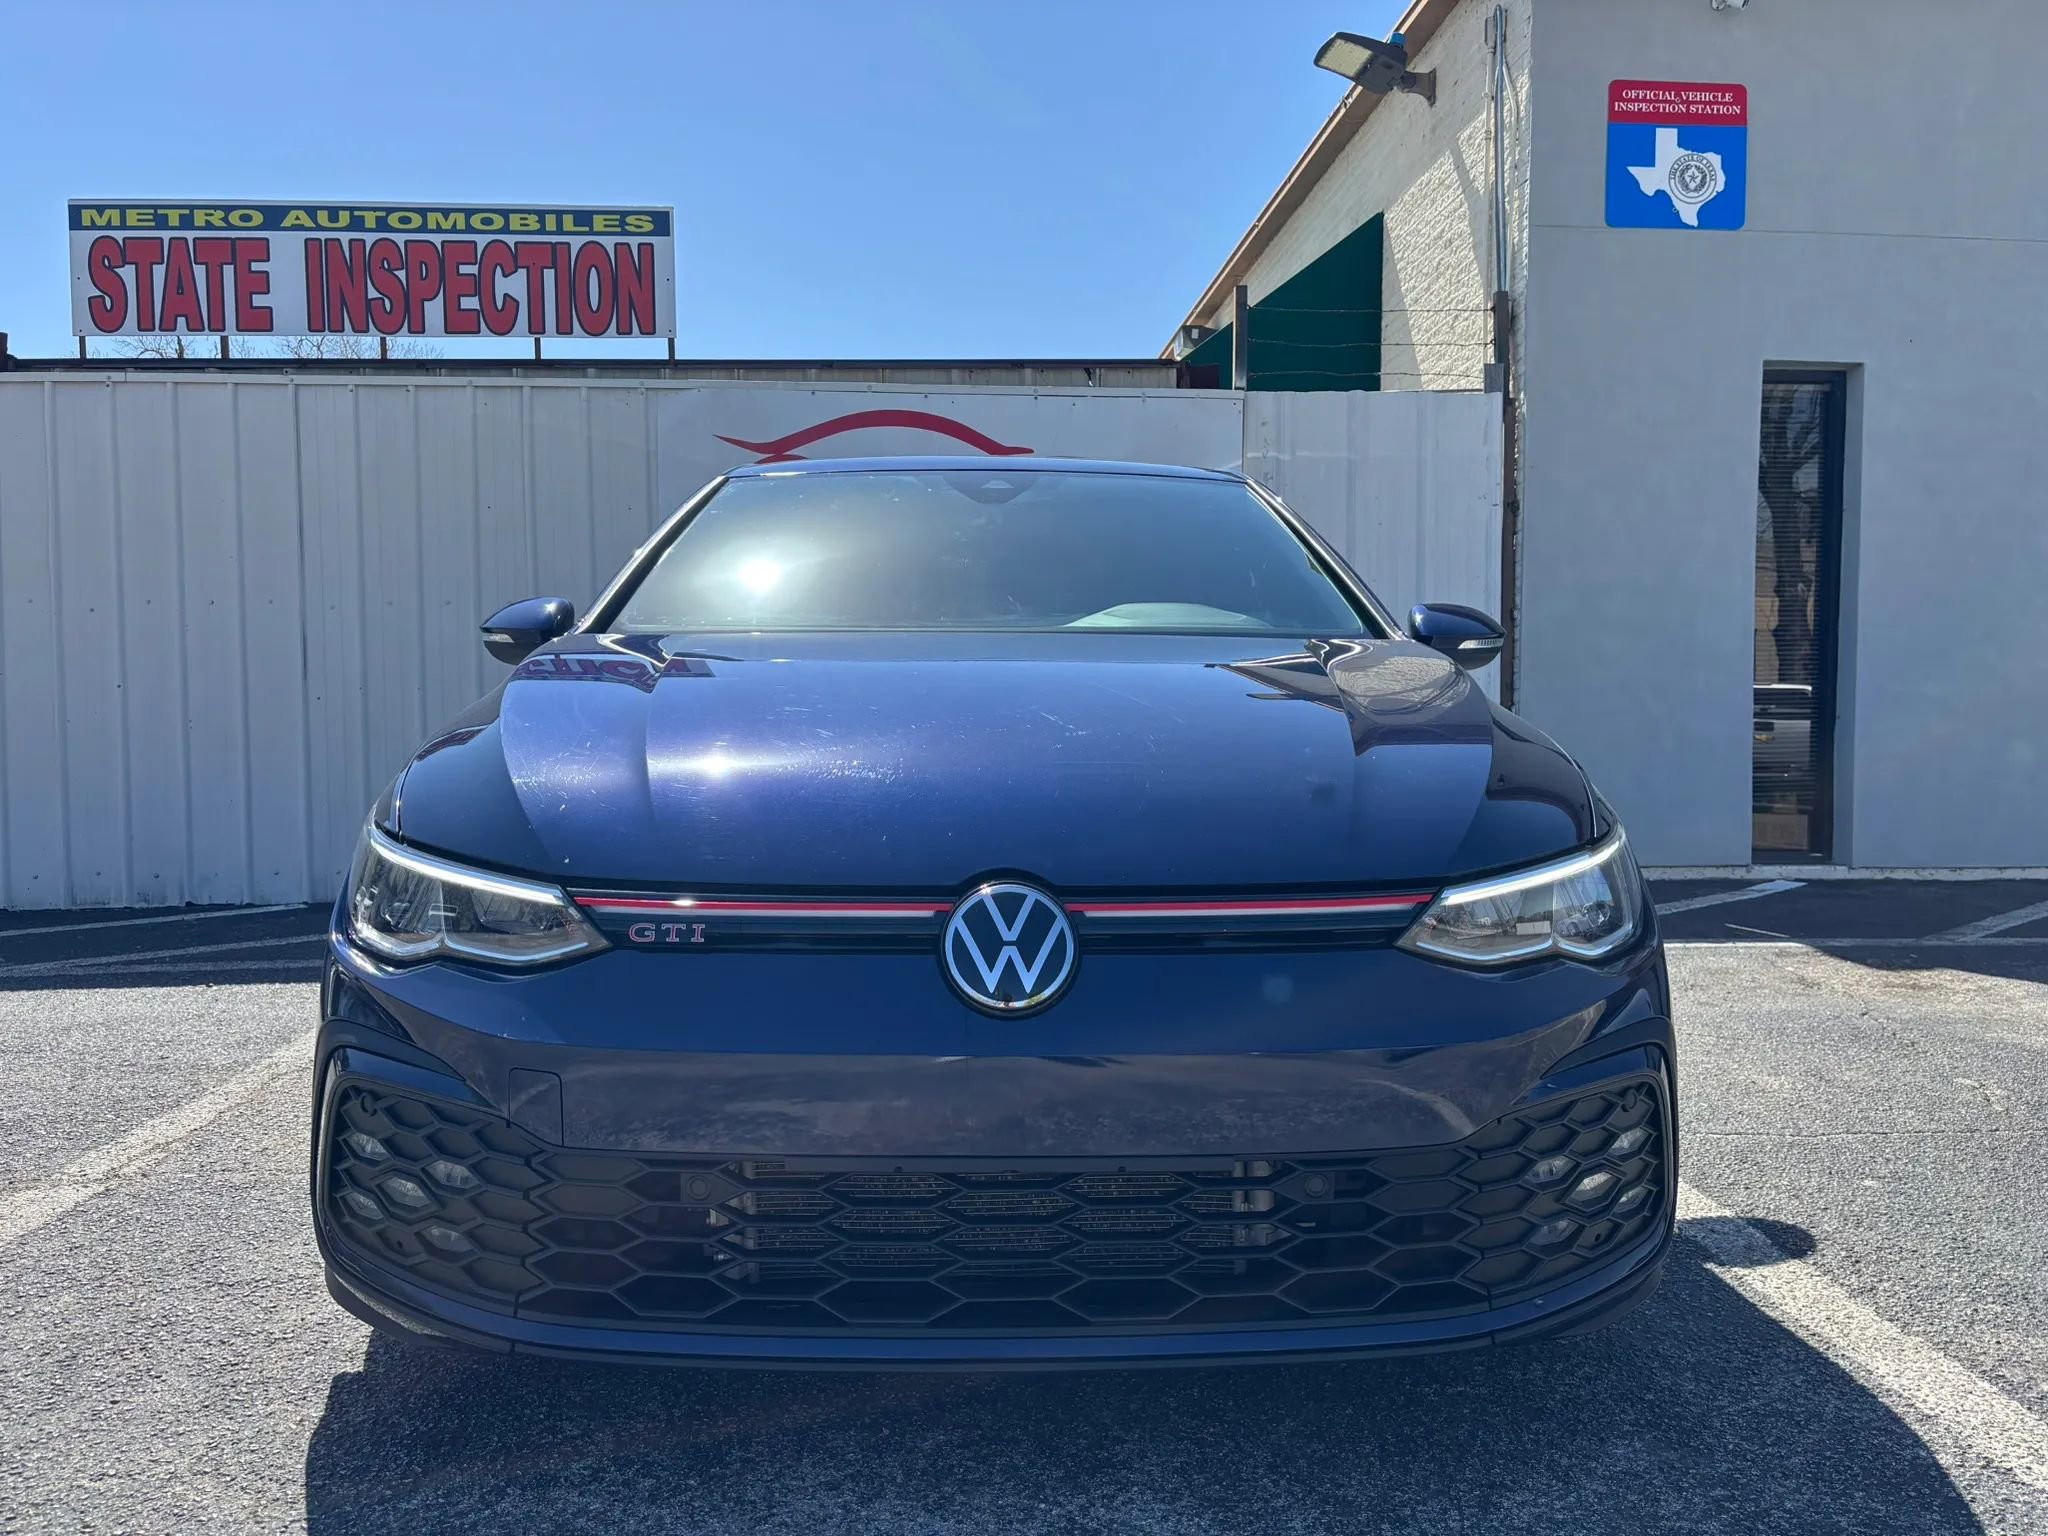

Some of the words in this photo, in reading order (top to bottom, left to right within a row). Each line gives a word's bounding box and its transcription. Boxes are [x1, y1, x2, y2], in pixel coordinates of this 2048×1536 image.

[1622, 89, 1676, 100] OFFICIAL
[1681, 91, 1733, 102] VEHICLE
[1614, 102, 1686, 113] INSPECTION
[1689, 104, 1741, 115] STATION
[81, 208, 264, 229] METRO
[281, 210, 656, 233] AUTOMOBILES
[88, 235, 274, 333] STATE
[304, 238, 656, 336] INSPECTION
[629, 922, 706, 942] GTI
